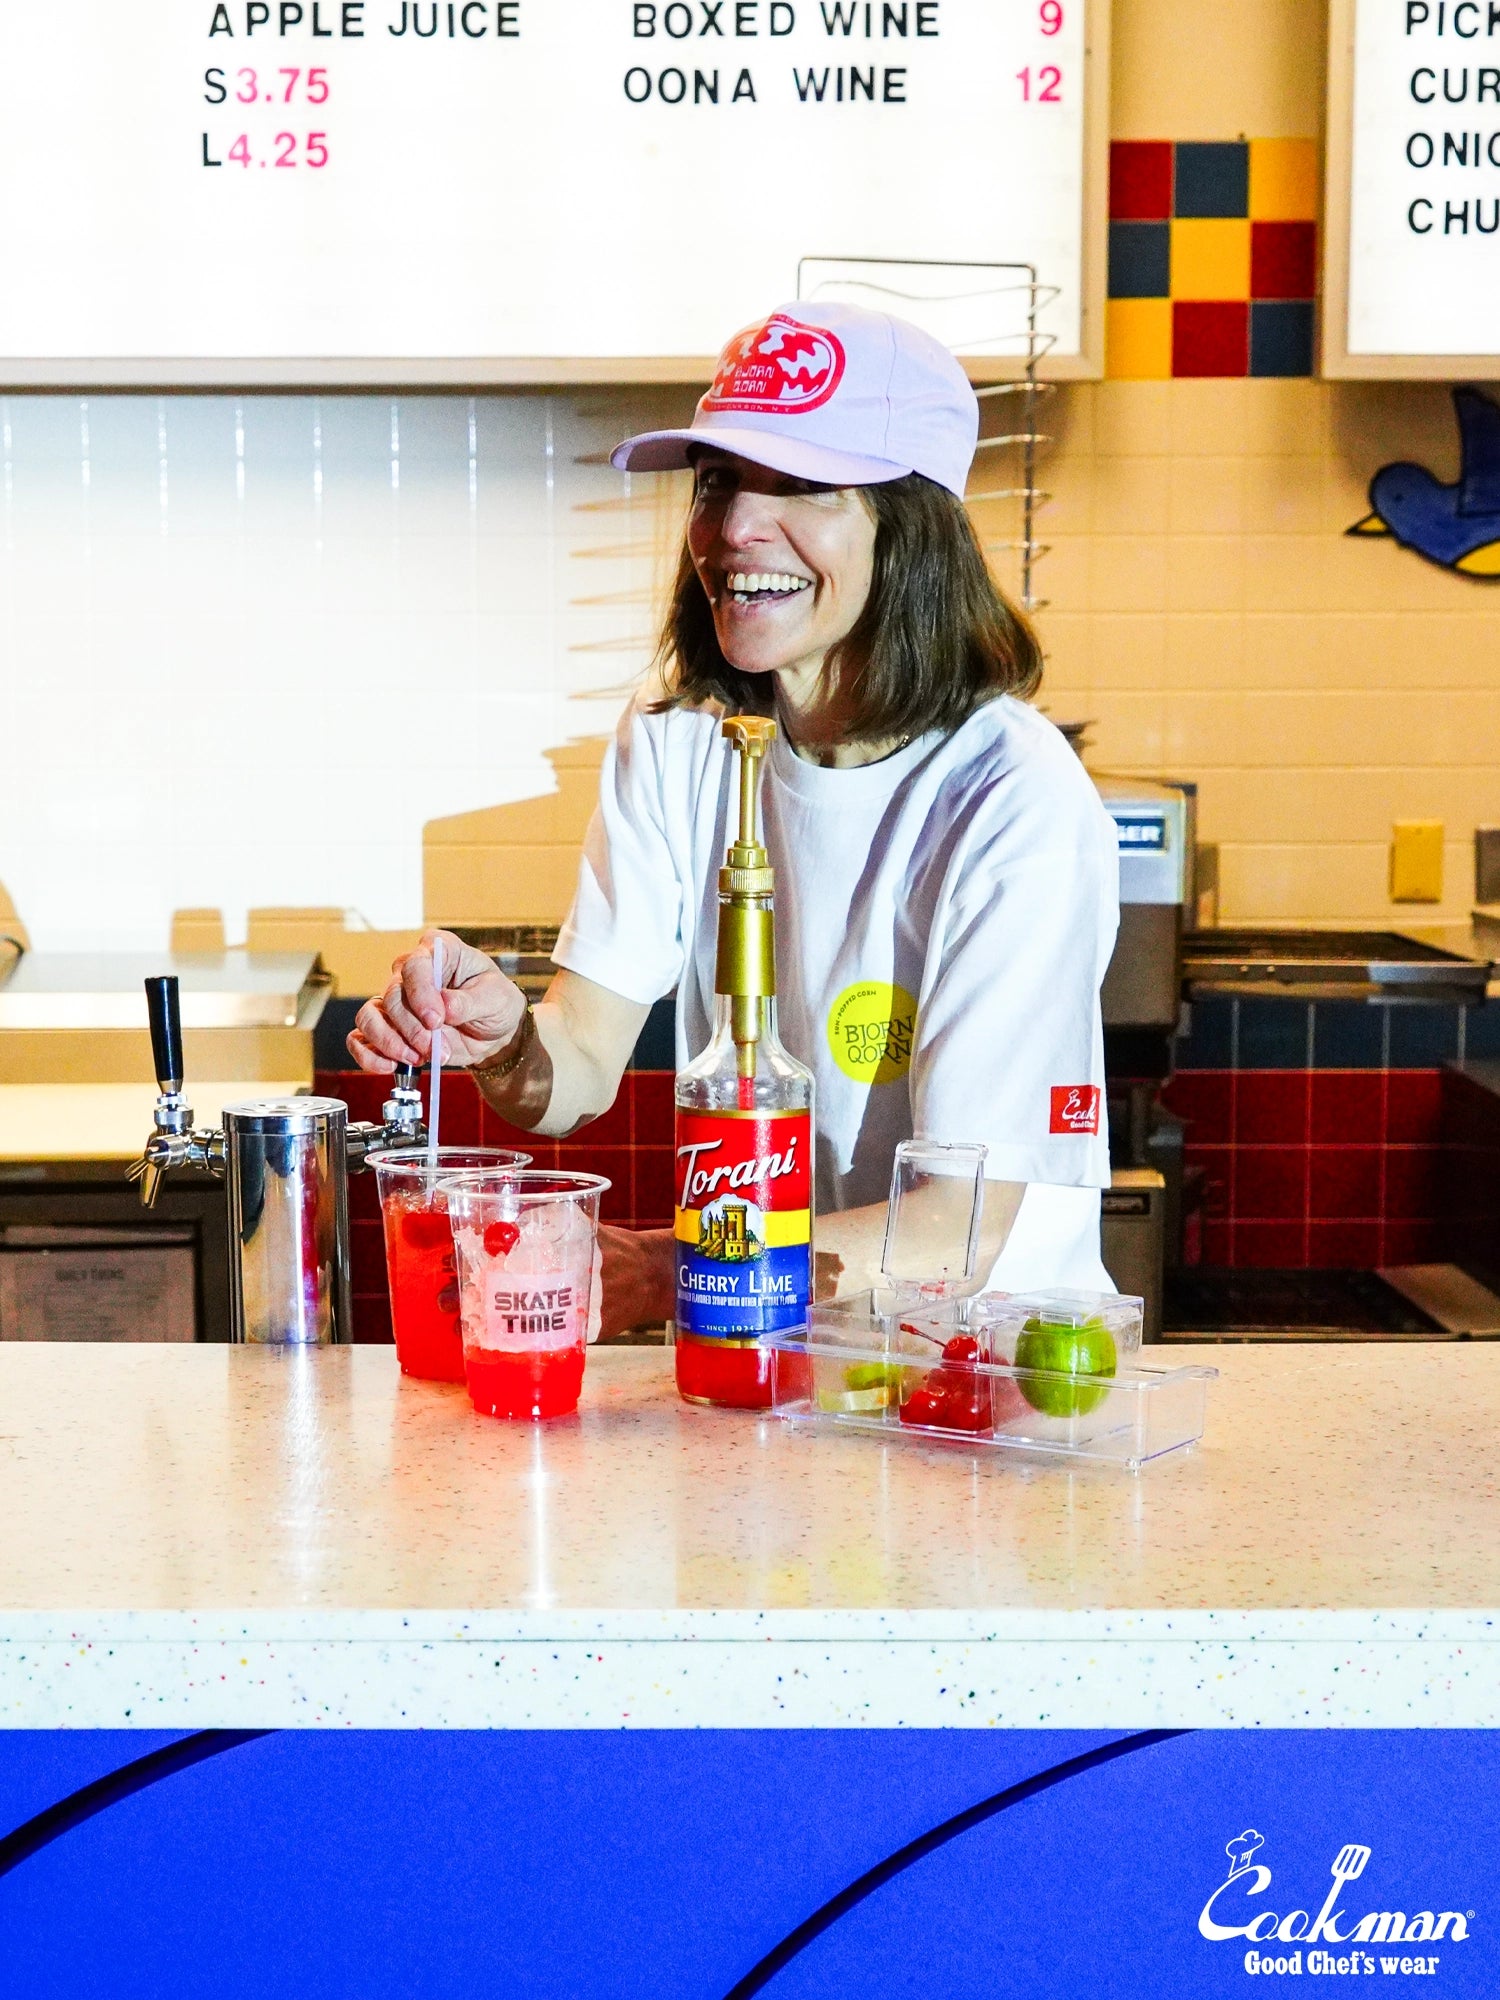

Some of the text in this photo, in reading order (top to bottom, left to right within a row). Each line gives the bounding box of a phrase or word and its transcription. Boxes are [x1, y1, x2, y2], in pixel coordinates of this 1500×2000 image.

[209, 2, 519, 38] APPLE JUICE
[634, 0, 1064, 38] BOXED WINE 9
[624, 66, 1062, 104] OONA WINE 12
[1411, 68, 1500, 103] CUR
[1408, 199, 1499, 234] CHU
[844, 1015, 915, 1048] BJORN
[847, 1038, 911, 1064] QORN
[677, 1136, 797, 1212] Torani
[494, 1287, 572, 1311] SKATE
[501, 1310, 567, 1334] TIME
[706, 1324, 728, 1332] SINCE
